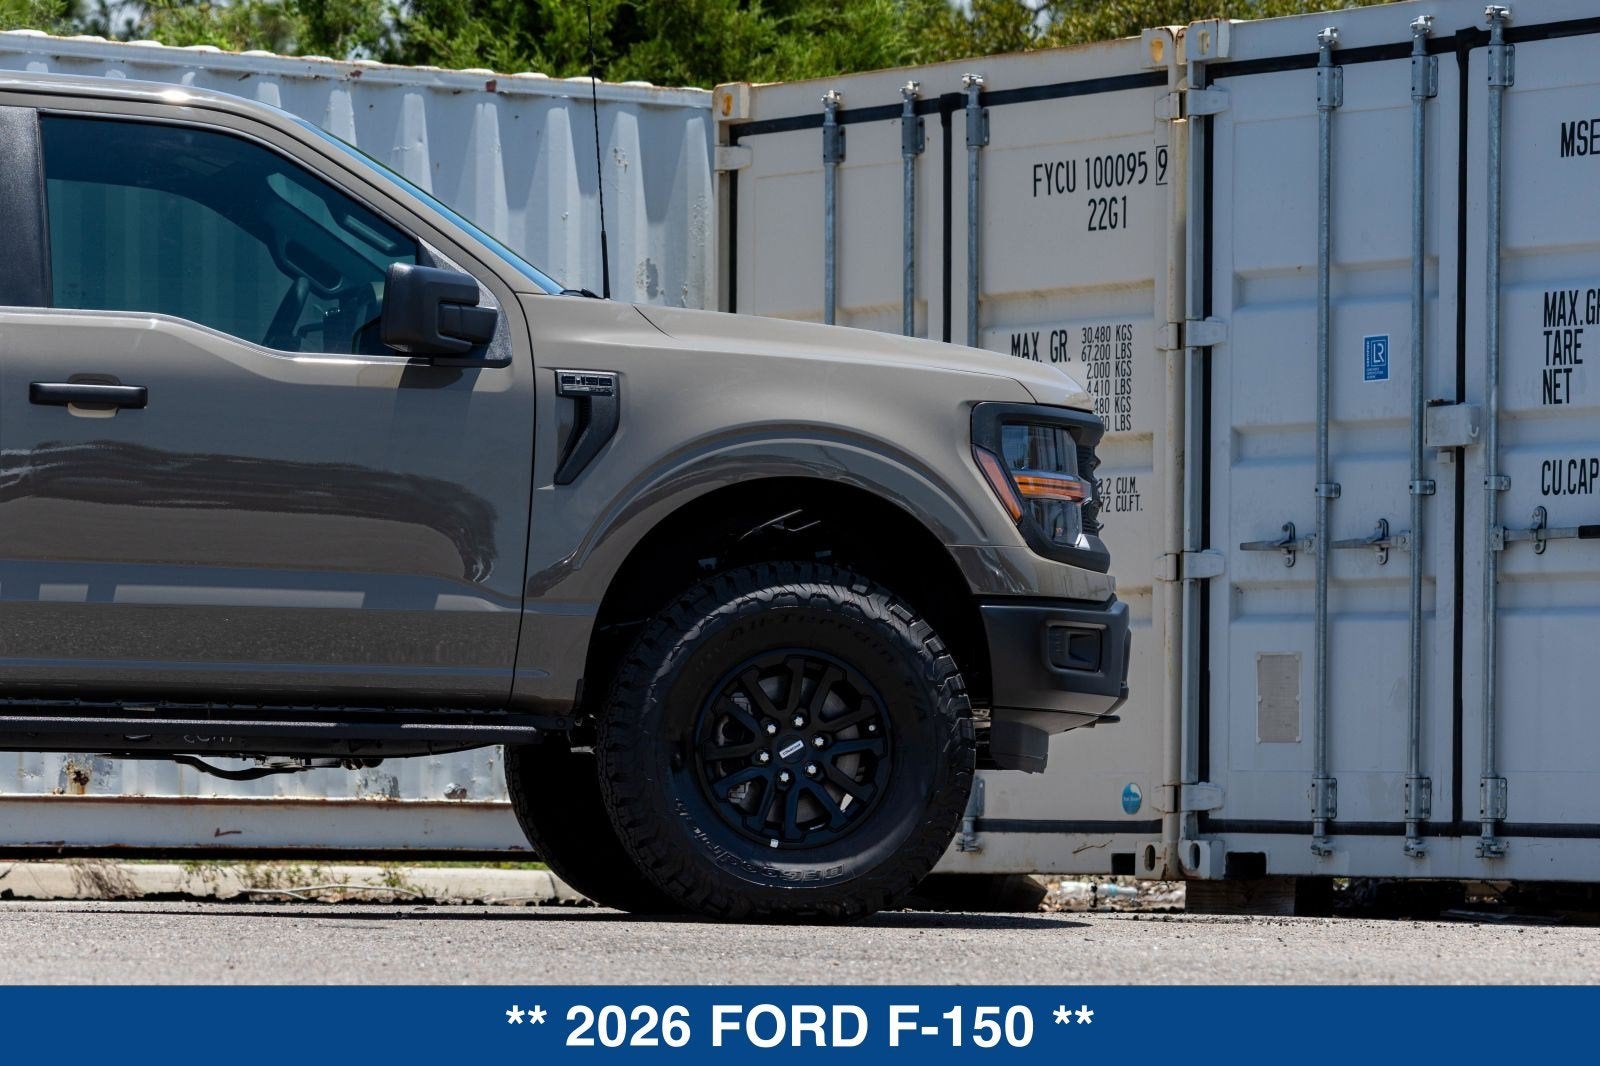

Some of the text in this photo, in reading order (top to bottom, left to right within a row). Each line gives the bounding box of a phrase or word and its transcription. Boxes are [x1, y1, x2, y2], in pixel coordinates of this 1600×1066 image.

[1033, 148, 1168, 197] FYCU 100095 9
[1088, 195, 1127, 231] 22G1
[1011, 324, 1133, 363] MAX. GR. 30.480 KGS
[1081, 343, 1132, 362] 67.200 LBS
[1543, 329, 1583, 366] TARE
[1087, 360, 1132, 379] 2.000 KGS
[1115, 378, 1132, 395] LBS
[1543, 368, 1572, 405] NET
[1115, 396, 1131, 413] KGS
[1115, 414, 1131, 431] LBS
[1116, 476, 1138, 494] CU.M.
[1116, 494, 1143, 512] CU.FT.
